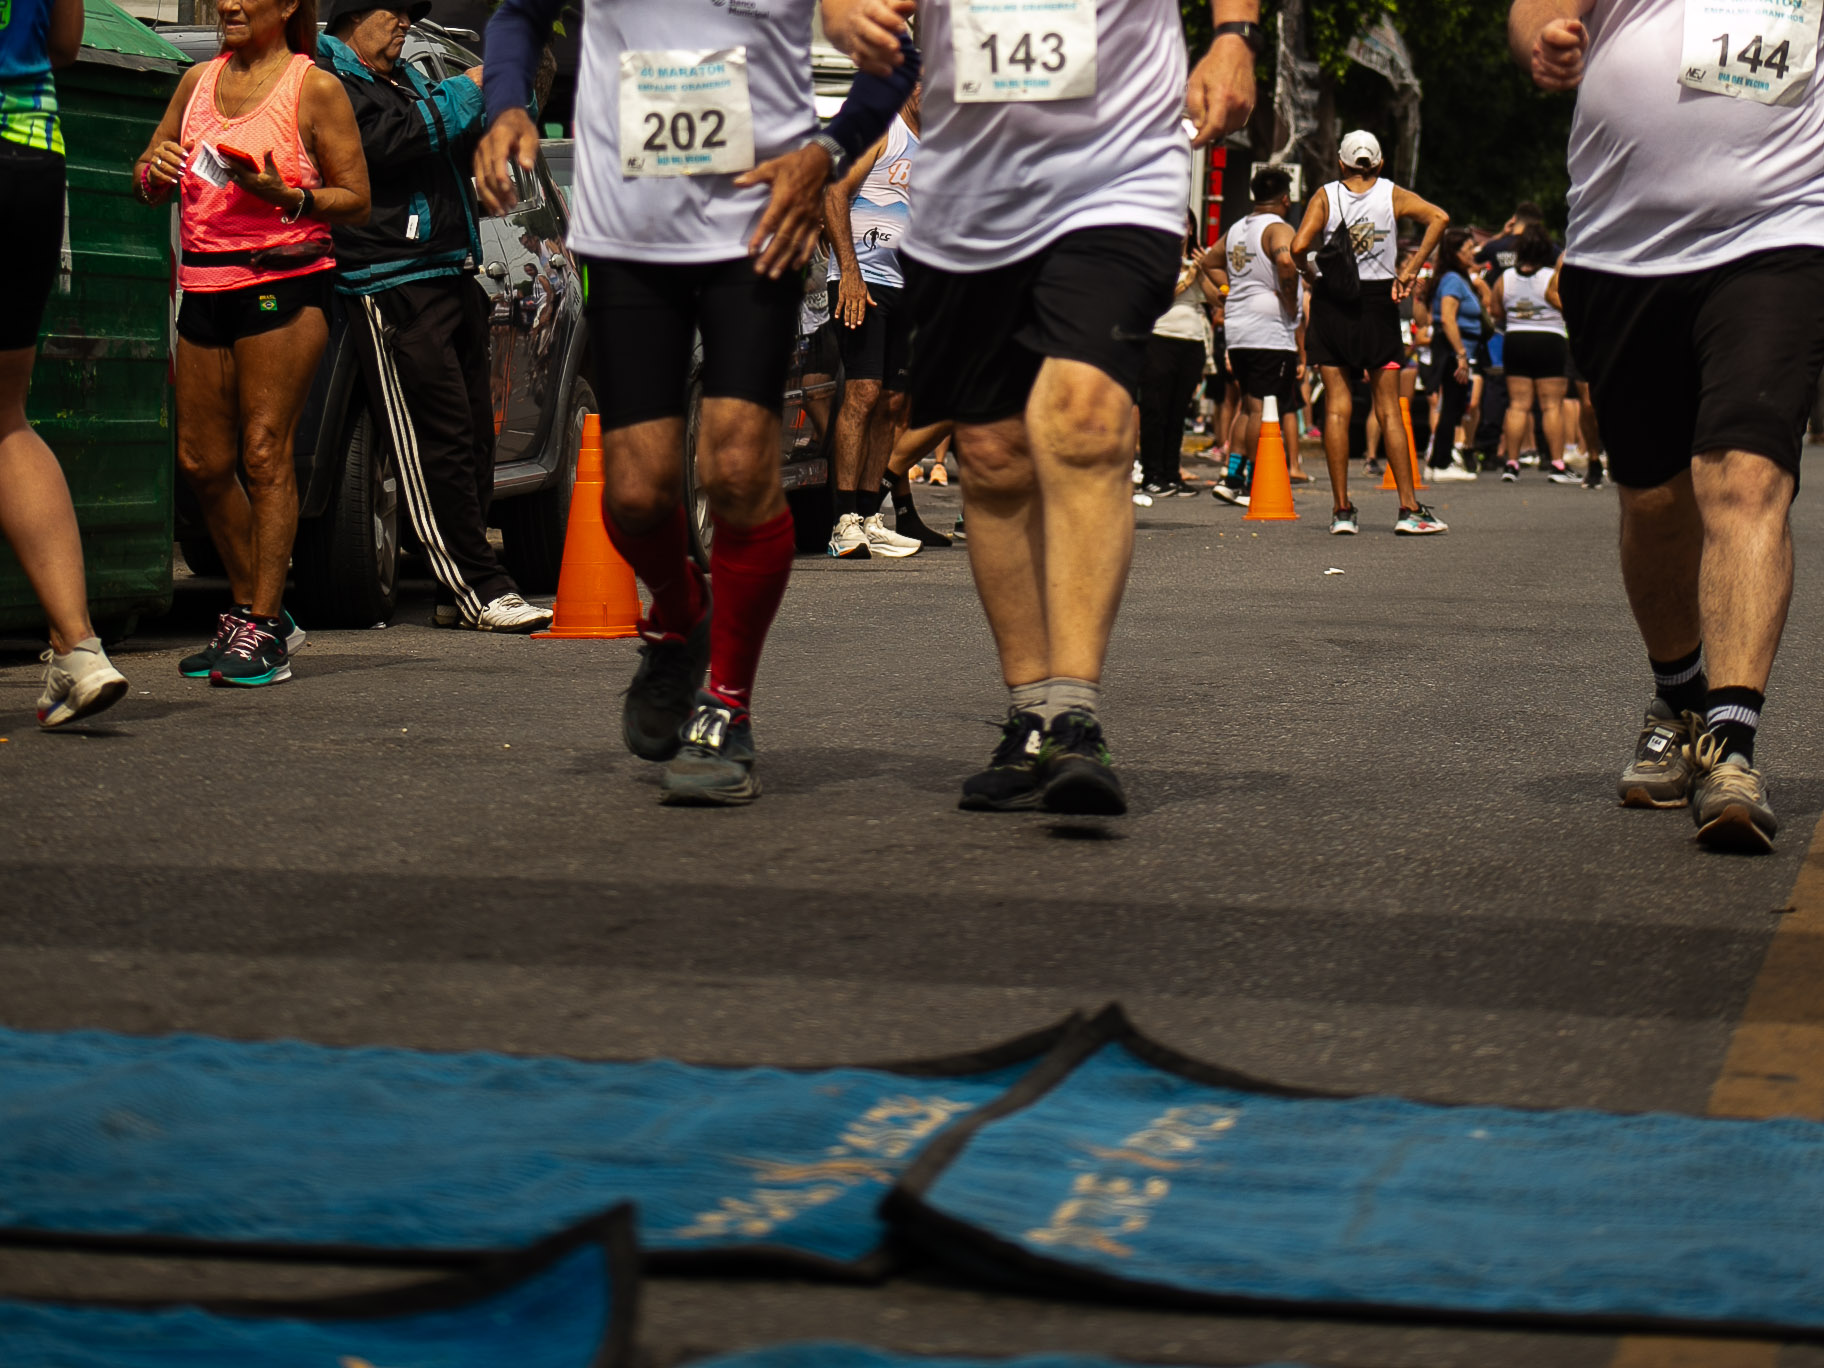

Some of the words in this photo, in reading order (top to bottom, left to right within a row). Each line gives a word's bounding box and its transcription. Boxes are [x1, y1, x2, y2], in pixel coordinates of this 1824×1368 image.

[640, 67, 654, 78] 40
[657, 64, 725, 78] MARATON
[981, 32, 1066, 73] 143
[1712, 34, 1790, 79] 144
[1744, 78, 1770, 91] VECINO
[643, 110, 727, 151] 202
